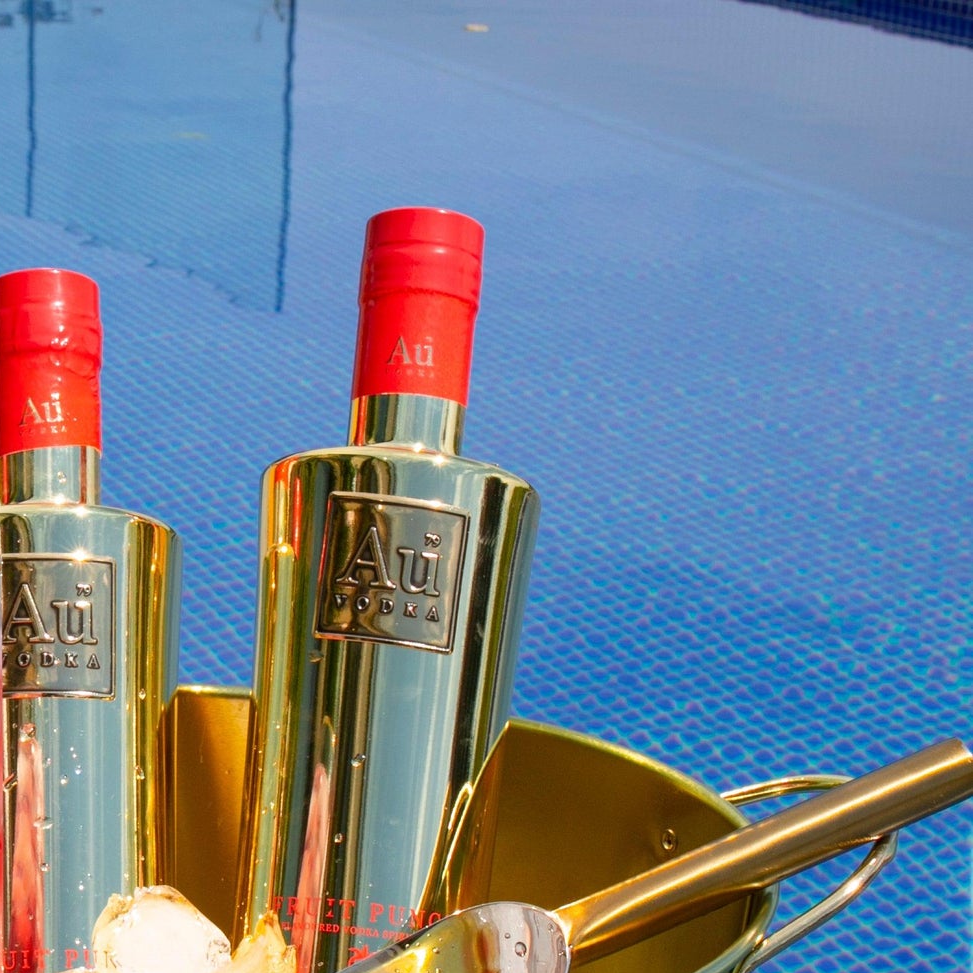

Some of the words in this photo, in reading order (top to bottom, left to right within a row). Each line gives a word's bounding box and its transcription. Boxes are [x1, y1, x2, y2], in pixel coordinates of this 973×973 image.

[387, 336, 434, 367] Au
[19, 397, 64, 427] Au
[335, 526, 441, 597] Au
[75, 583, 93, 597] 79
[2, 583, 98, 645] Au
[334, 593, 440, 622] VODKA
[272, 896, 356, 920] FRUIT
[369, 902, 442, 929] PUNC
[2, 949, 51, 971] UIT
